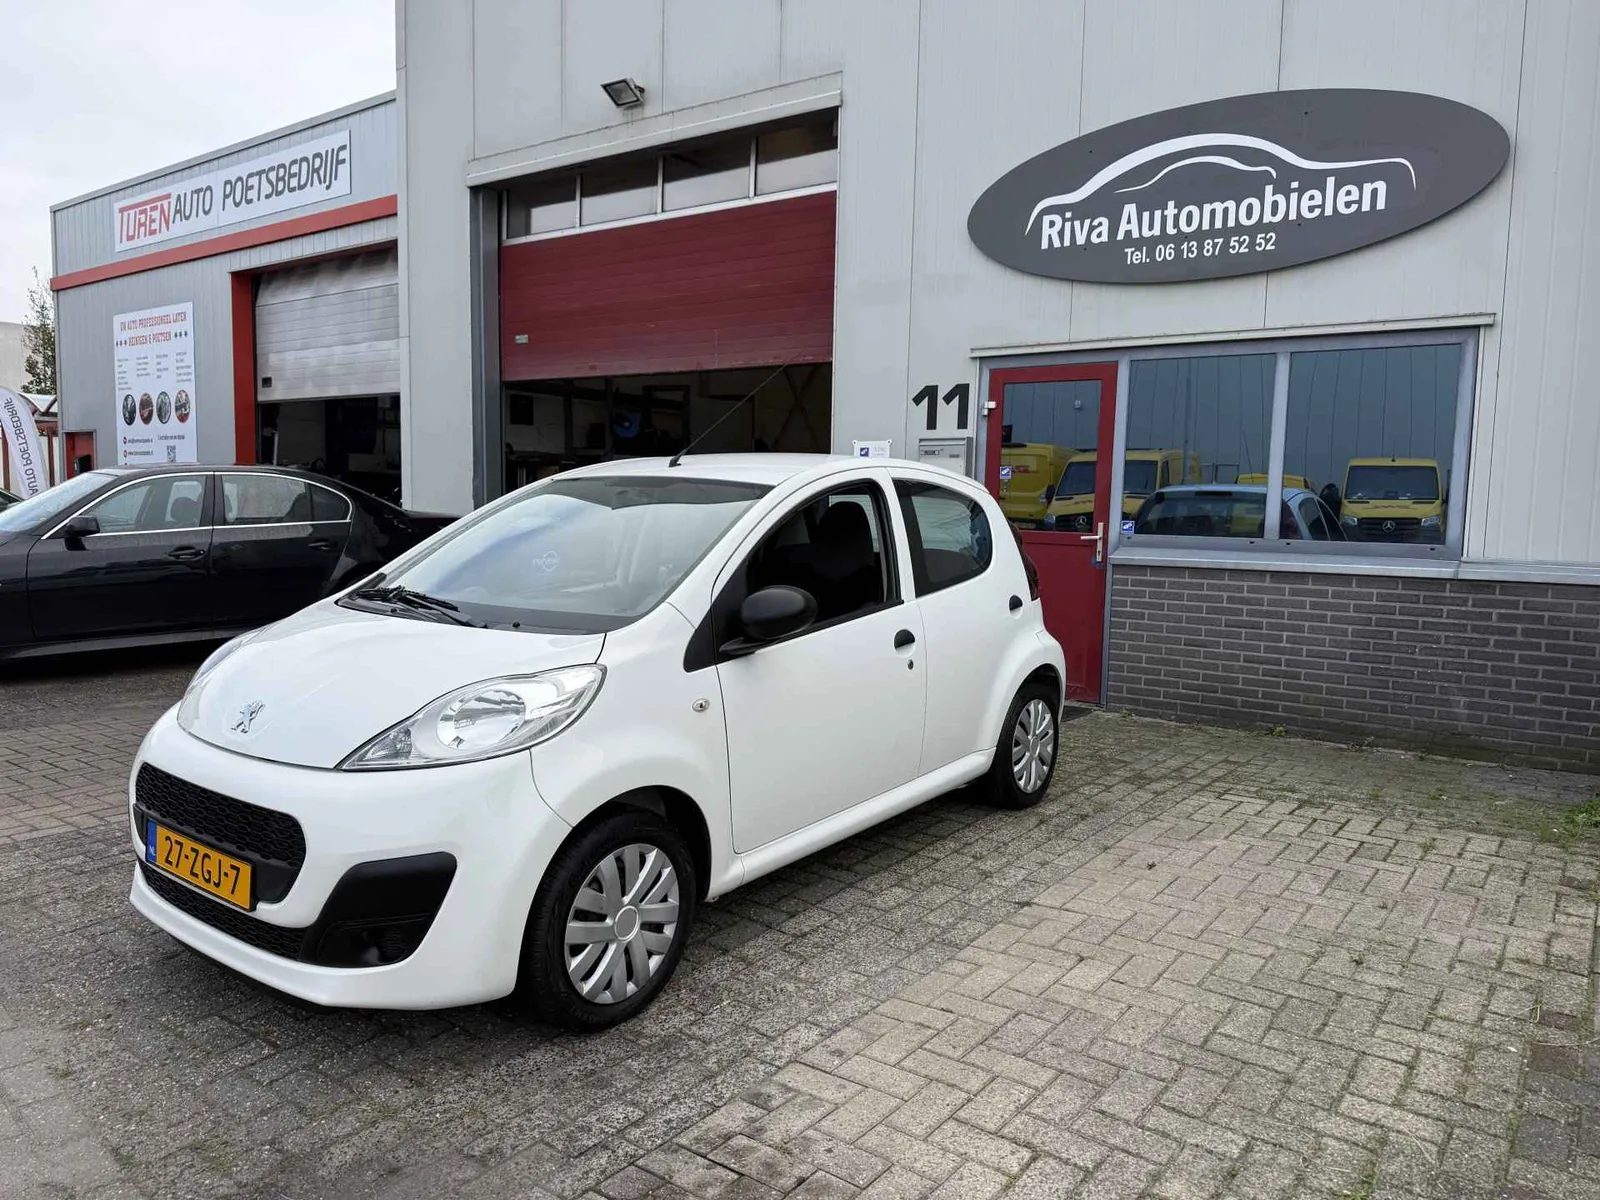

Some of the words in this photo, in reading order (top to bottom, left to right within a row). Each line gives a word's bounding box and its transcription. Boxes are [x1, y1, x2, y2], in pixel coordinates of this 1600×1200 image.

[118, 193, 172, 244] TUREN
[172, 185, 214, 224] AUTO
[222, 144, 348, 211] POETSBEDRIJF
[1040, 211, 1109, 250] Riva
[1116, 176, 1387, 241] Automobielen
[1124, 246, 1149, 265] Tel.
[1155, 243, 1175, 262] 06
[1180, 240, 1198, 259] 13
[1203, 238, 1224, 257] 87
[1228, 235, 1250, 254] 52
[1255, 232, 1276, 251] 52
[911, 382, 970, 431] 11
[164, 835, 241, 895] 27-ZGJ-7
